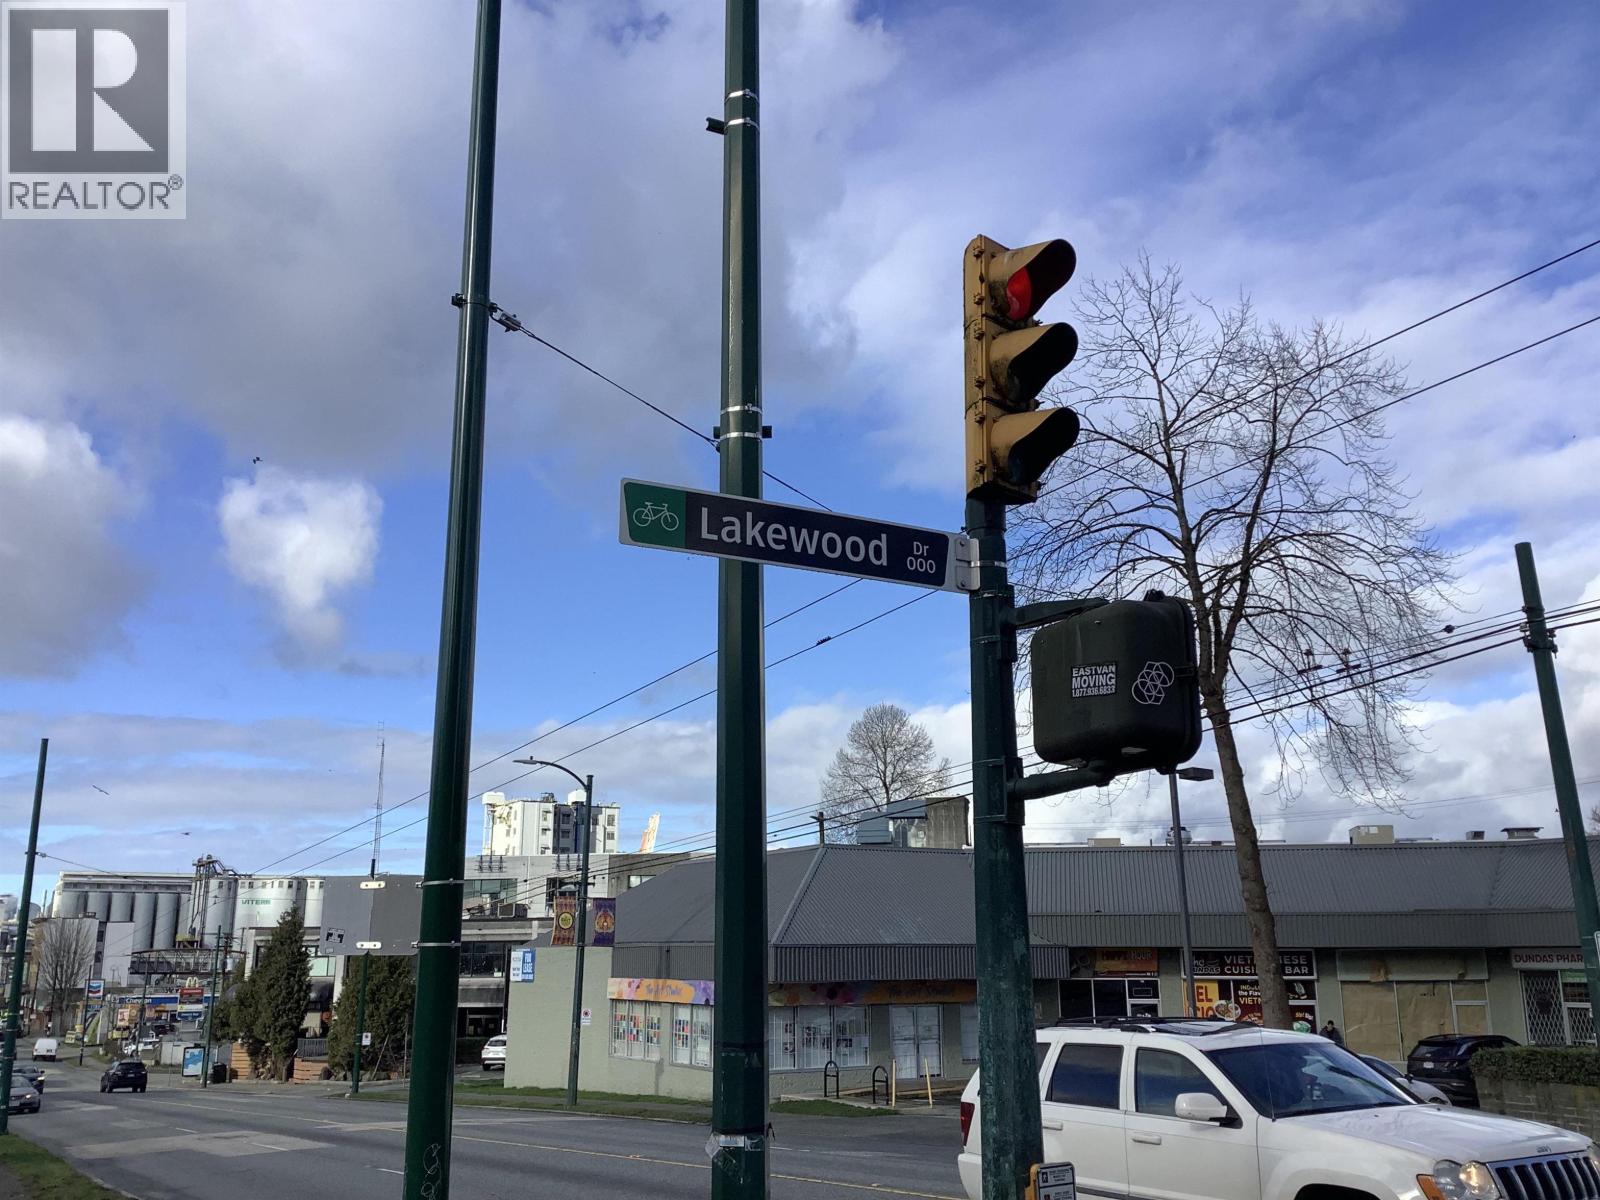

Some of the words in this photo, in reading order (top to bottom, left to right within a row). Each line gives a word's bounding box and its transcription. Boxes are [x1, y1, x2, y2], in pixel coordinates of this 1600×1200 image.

[701, 507, 888, 566] Lakewood
[913, 541, 930, 556] Dr
[1072, 673, 1116, 689] MOVING
[1514, 953, 1554, 963] DUNDAS
[1556, 953, 1583, 963] PHAR
[1224, 966, 1258, 974] CUISI
[1285, 966, 1309, 974] BAR
